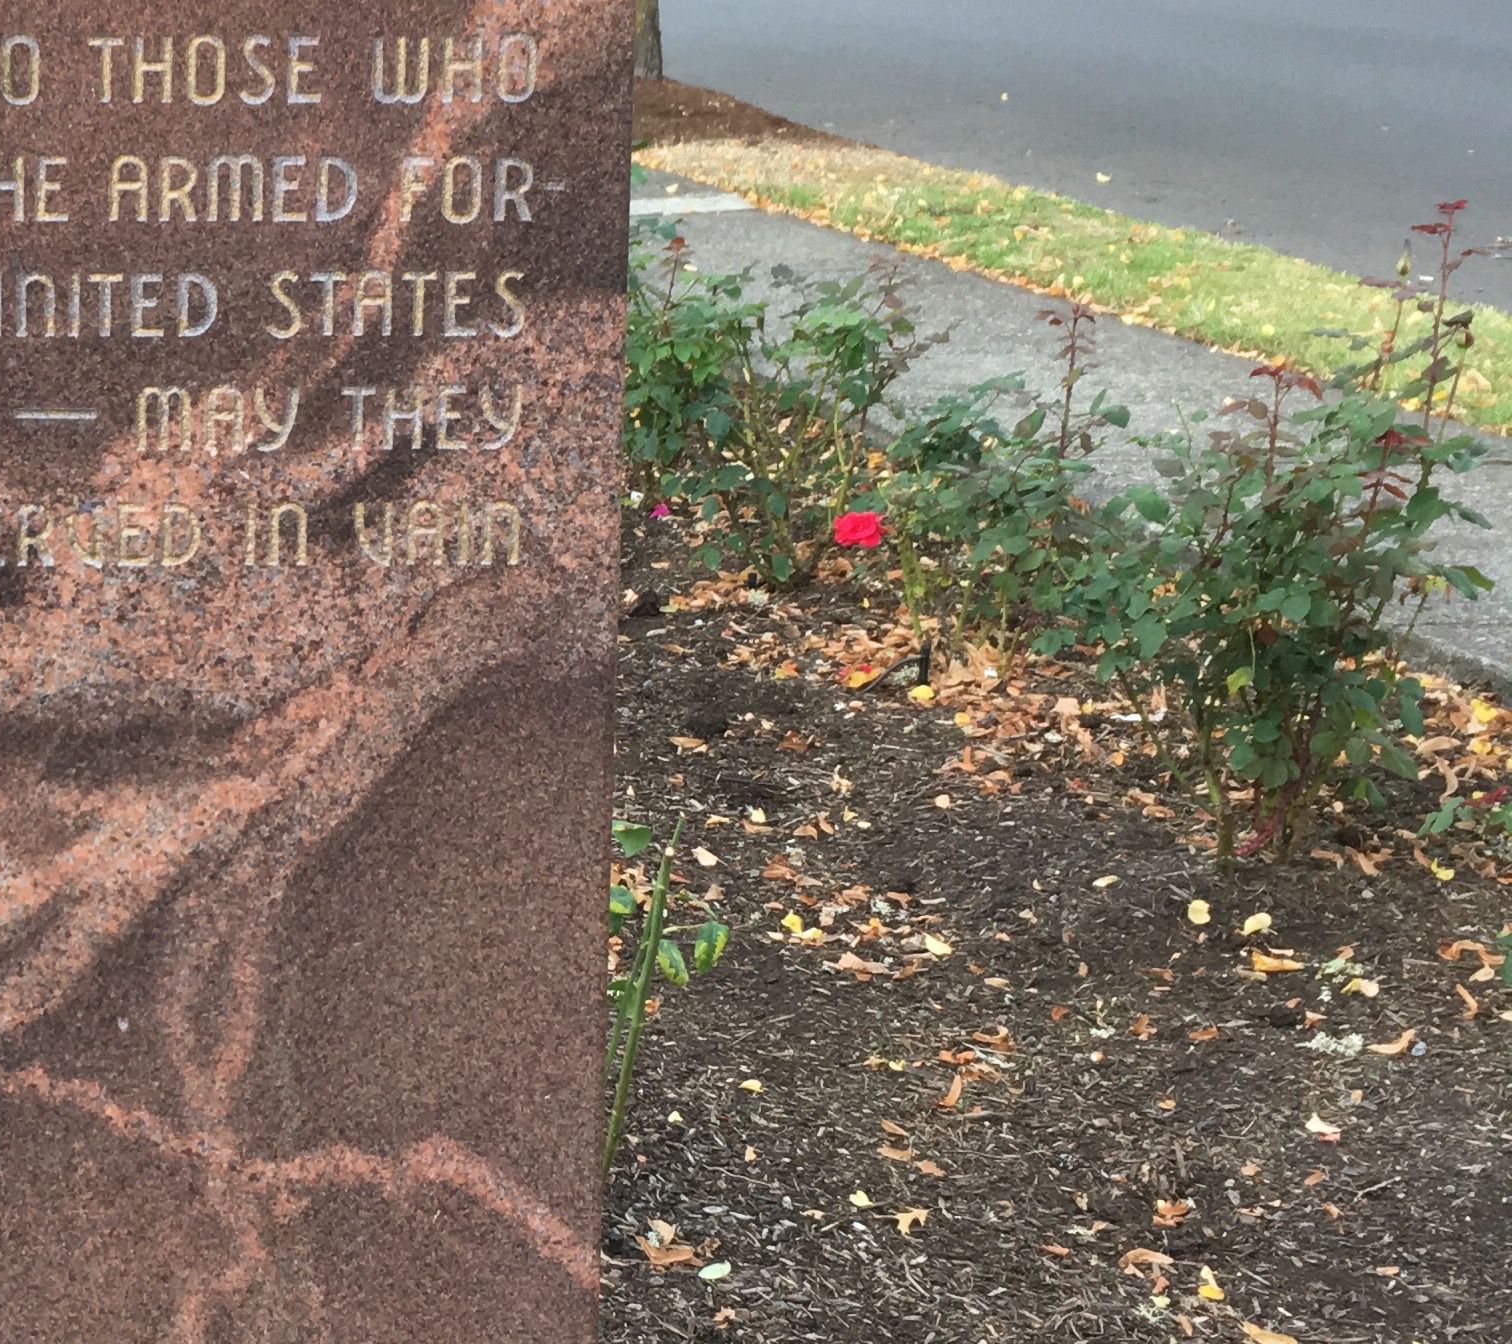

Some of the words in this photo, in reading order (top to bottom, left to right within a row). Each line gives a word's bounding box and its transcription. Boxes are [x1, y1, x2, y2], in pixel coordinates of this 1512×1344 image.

[88, 35, 322, 106] THOSE
[372, 35, 538, 105] WHO
[108, 155, 358, 223] ARMED
[399, 155, 566, 224] FOR-
[267, 270, 526, 338] STATES
[135, 385, 300, 453] MAY
[341, 383, 525, 451] THEY
[244, 499, 308, 567] IN
[353, 499, 523, 566] VAIN
